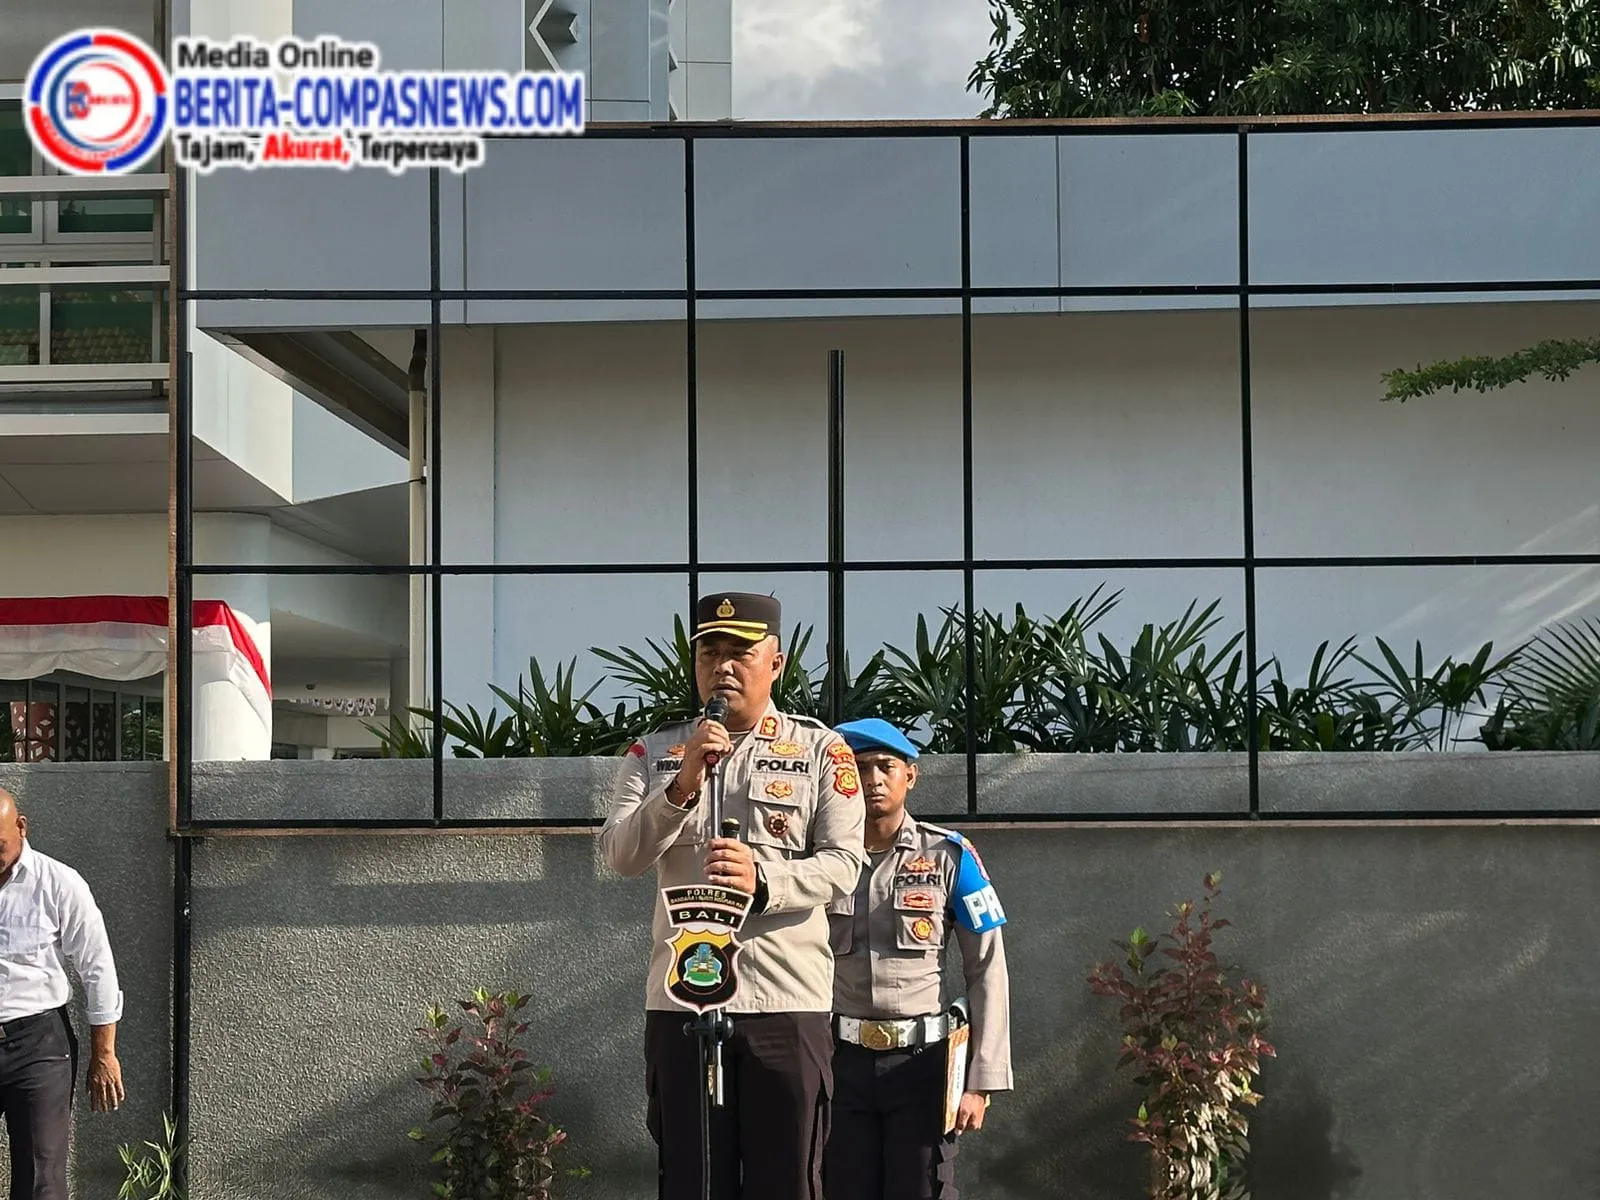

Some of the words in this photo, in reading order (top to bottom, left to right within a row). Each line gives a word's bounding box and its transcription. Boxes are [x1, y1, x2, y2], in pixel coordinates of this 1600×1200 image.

[756, 759, 810, 774] POLRI
[896, 873, 942, 886] POLRI
[687, 888, 727, 899] POLRES
[679, 910, 736, 924] BALI
